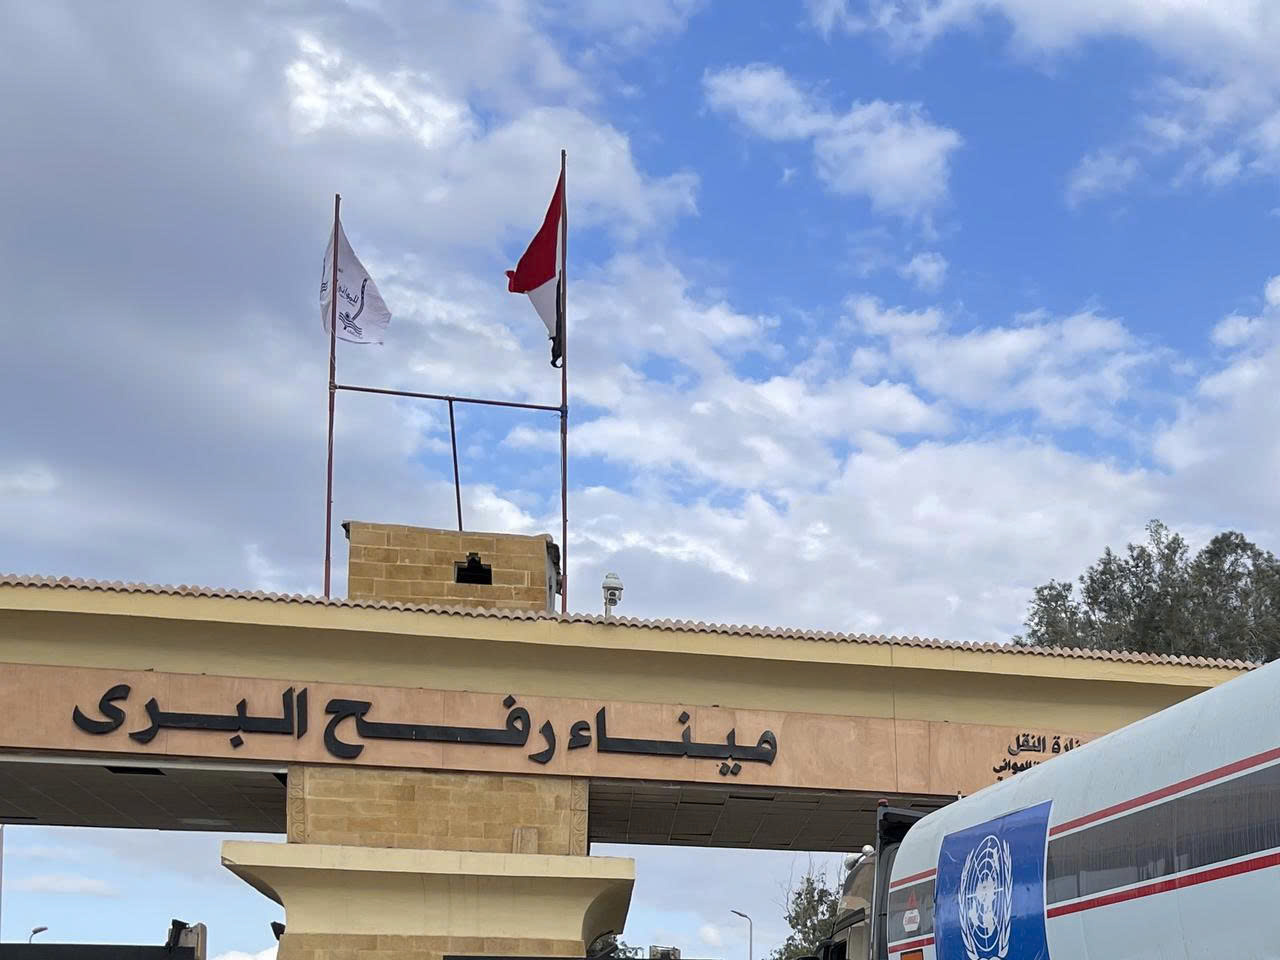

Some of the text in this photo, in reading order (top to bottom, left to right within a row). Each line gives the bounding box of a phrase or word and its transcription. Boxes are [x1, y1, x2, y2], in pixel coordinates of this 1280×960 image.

[323, 694, 556, 764] رفح
[568, 705, 779, 776] ميناء
[1008, 733, 1047, 757] النقل
